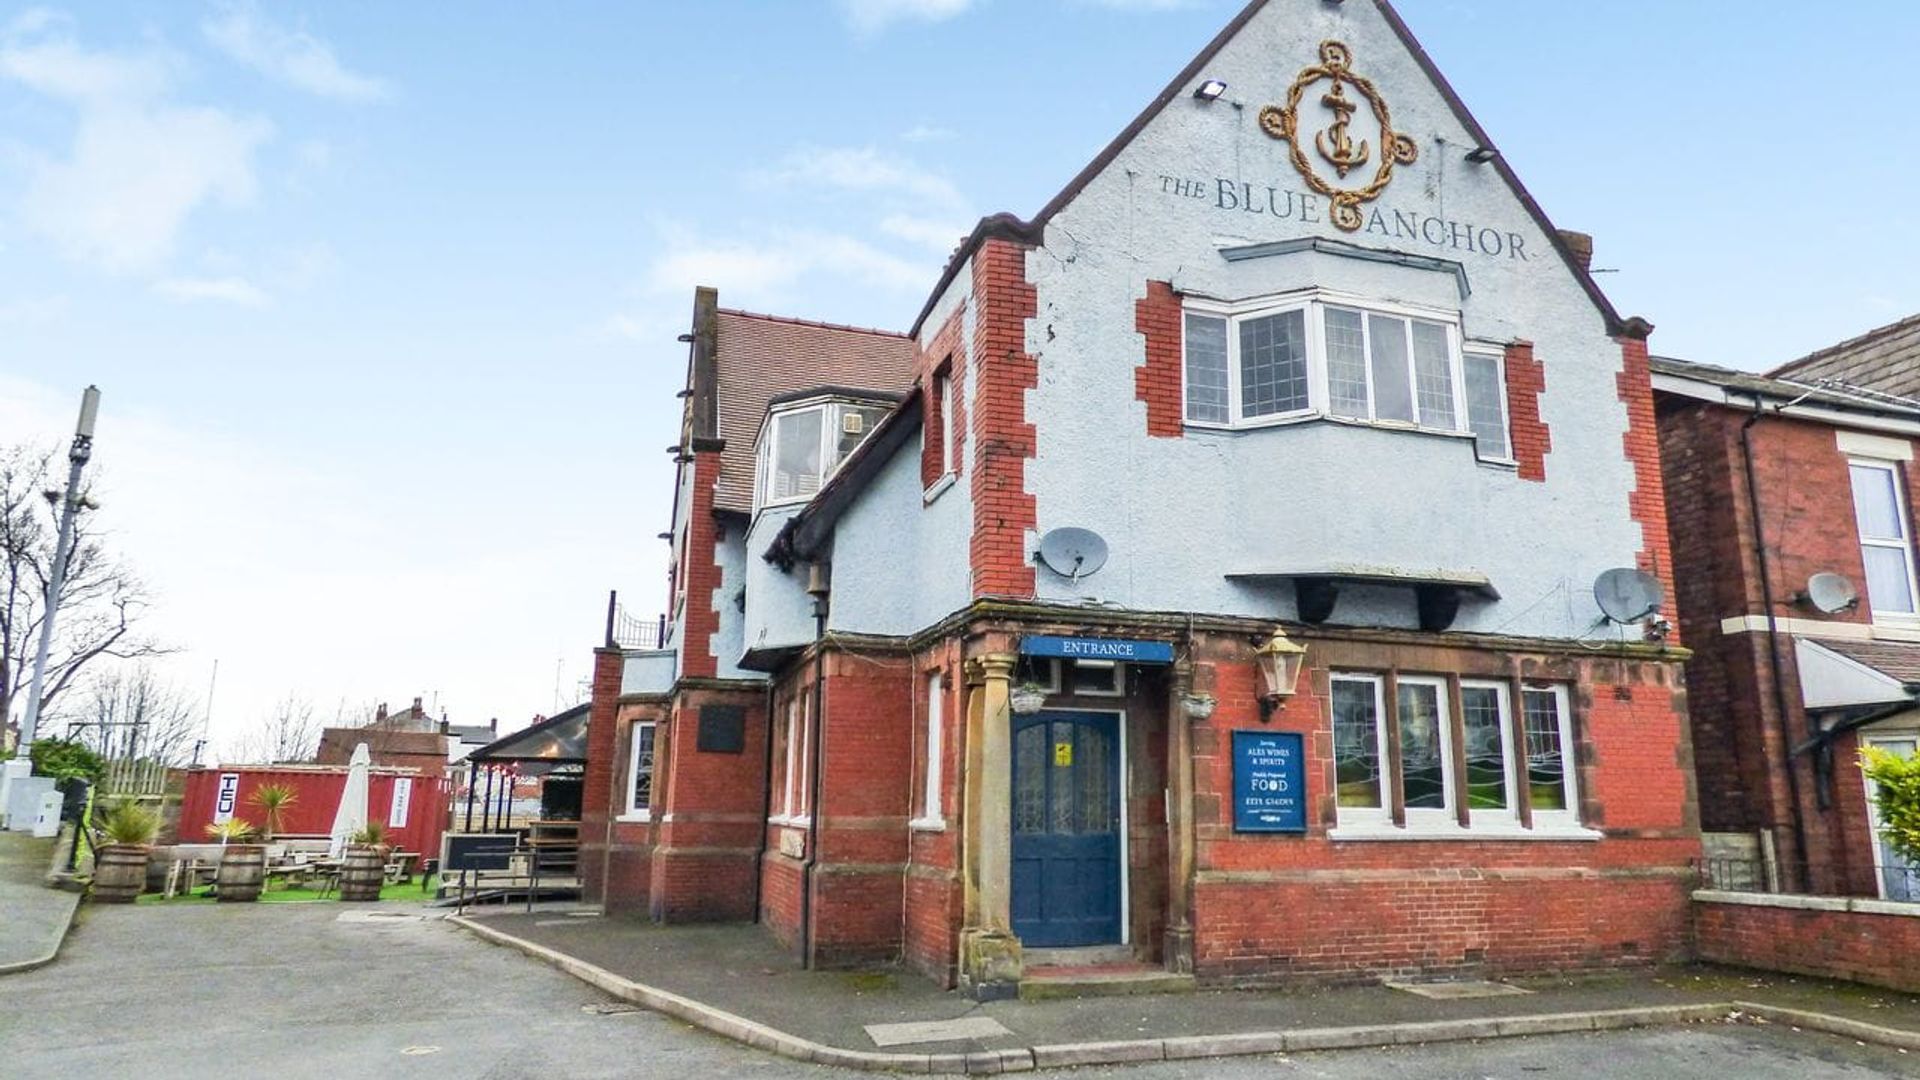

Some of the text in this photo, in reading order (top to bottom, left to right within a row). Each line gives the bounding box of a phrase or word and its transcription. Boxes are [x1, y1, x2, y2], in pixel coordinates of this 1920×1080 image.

[1160, 175, 1527, 261] THE BLUE ANCHOR
[1063, 641, 1134, 656] ENTRANCE
[1248, 748, 1265, 756] ALES
[1251, 779, 1288, 791] FOOD
[1246, 797, 1263, 805] BEER
